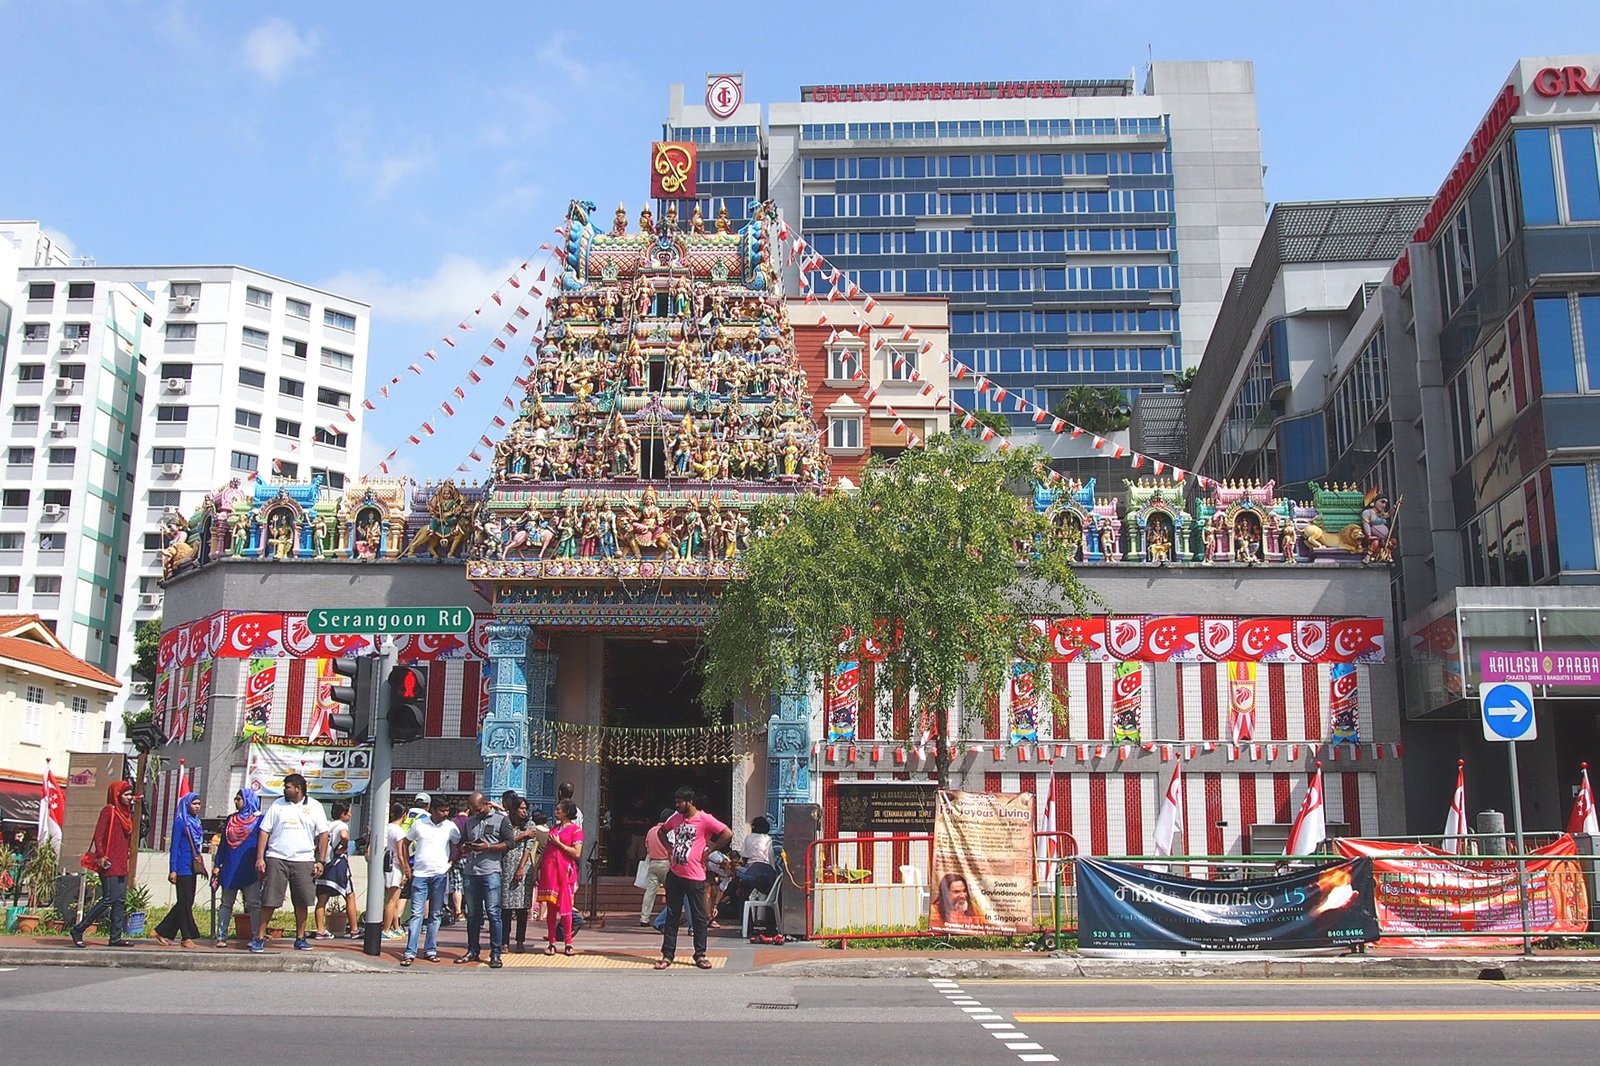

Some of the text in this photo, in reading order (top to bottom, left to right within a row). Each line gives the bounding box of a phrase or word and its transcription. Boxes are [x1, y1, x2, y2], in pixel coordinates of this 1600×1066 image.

[812, 80, 1069, 103] GRAND IMPERIAL HOTEL
[318, 610, 462, 631] Serangoon Rd
[1489, 656, 1539, 673] KAILASH
[999, 808, 1030, 820] Living
[994, 880, 1017, 888] Swami
[994, 914, 1028, 923] Singapore
[1093, 930, 1107, 938] $20
[1327, 928, 1364, 938] 8401 8486
